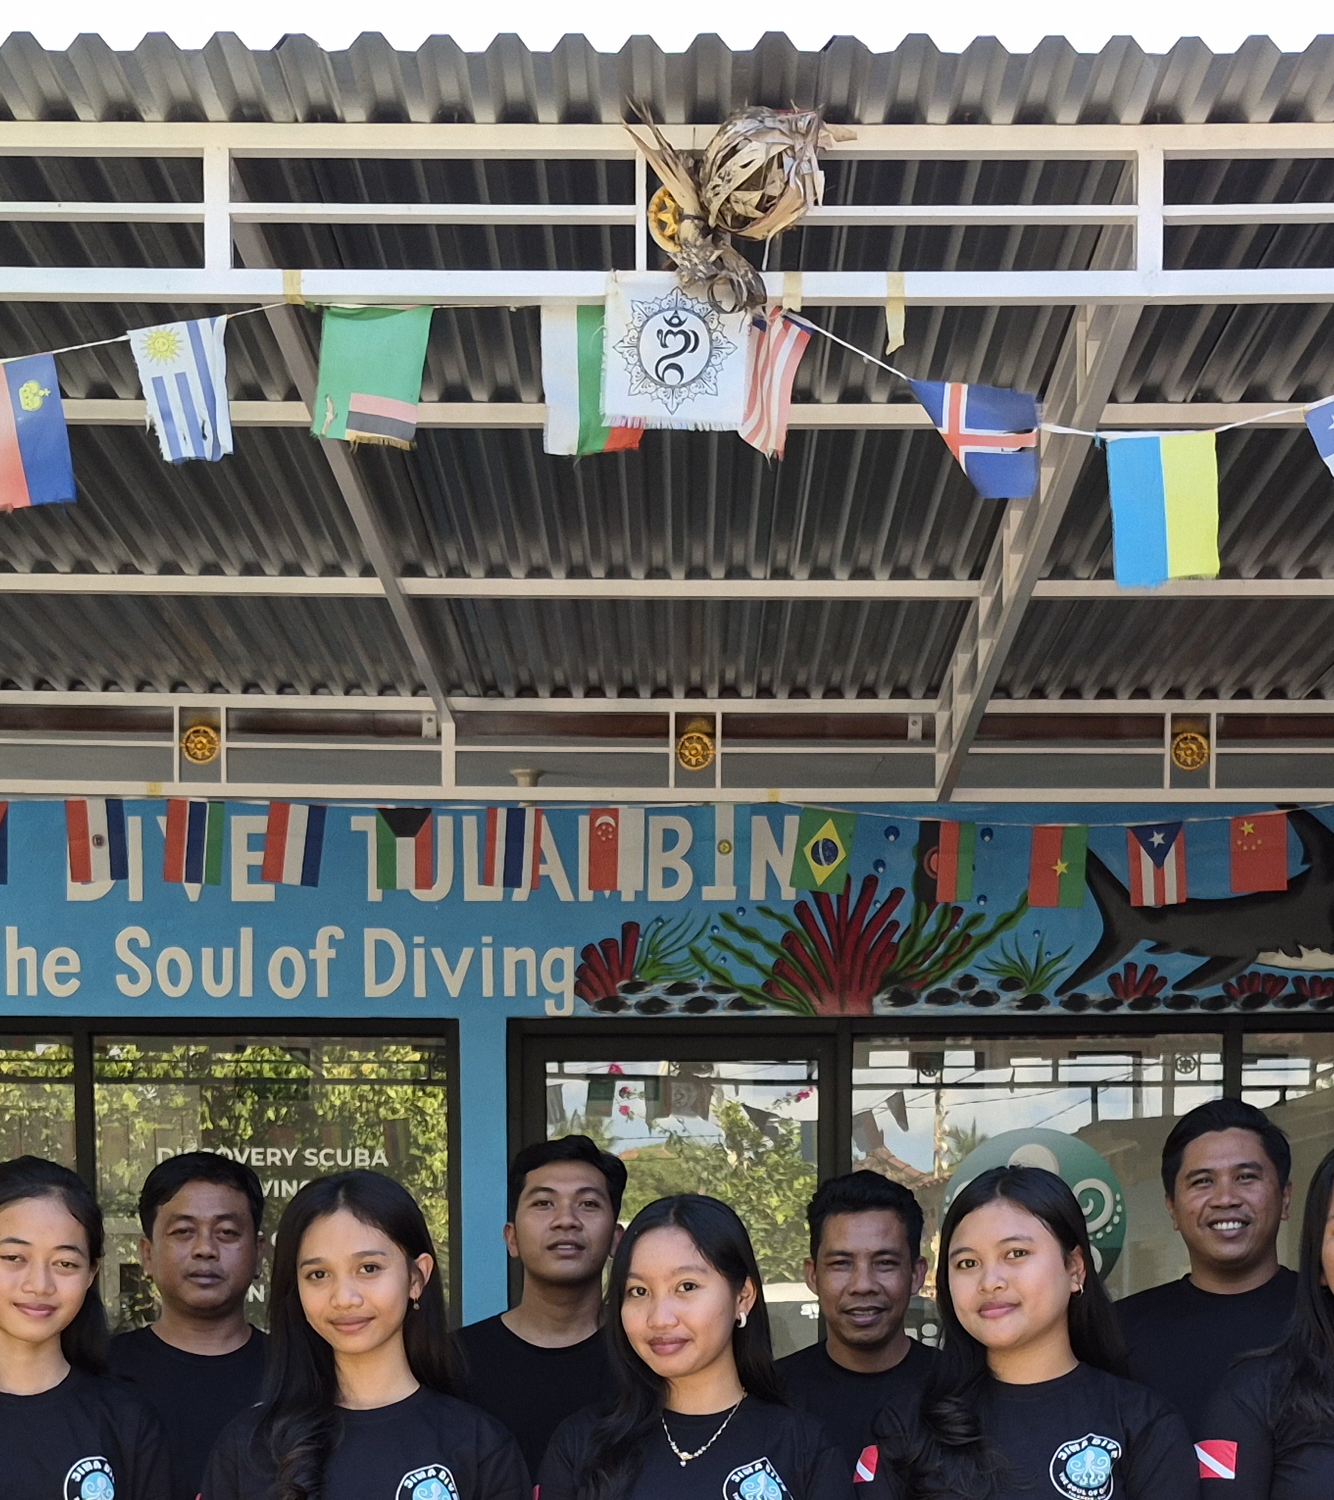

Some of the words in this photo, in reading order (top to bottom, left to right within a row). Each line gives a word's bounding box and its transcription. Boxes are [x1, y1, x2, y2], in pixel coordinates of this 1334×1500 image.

[66, 815, 276, 902] IE
[114, 925, 254, 998] Soul
[267, 925, 346, 1000] of
[363, 926, 576, 1017] Diving
[156, 1147, 298, 1167] DOVERY
[303, 1148, 390, 1167] SCUBA
[260, 1180, 312, 1198] VIN
